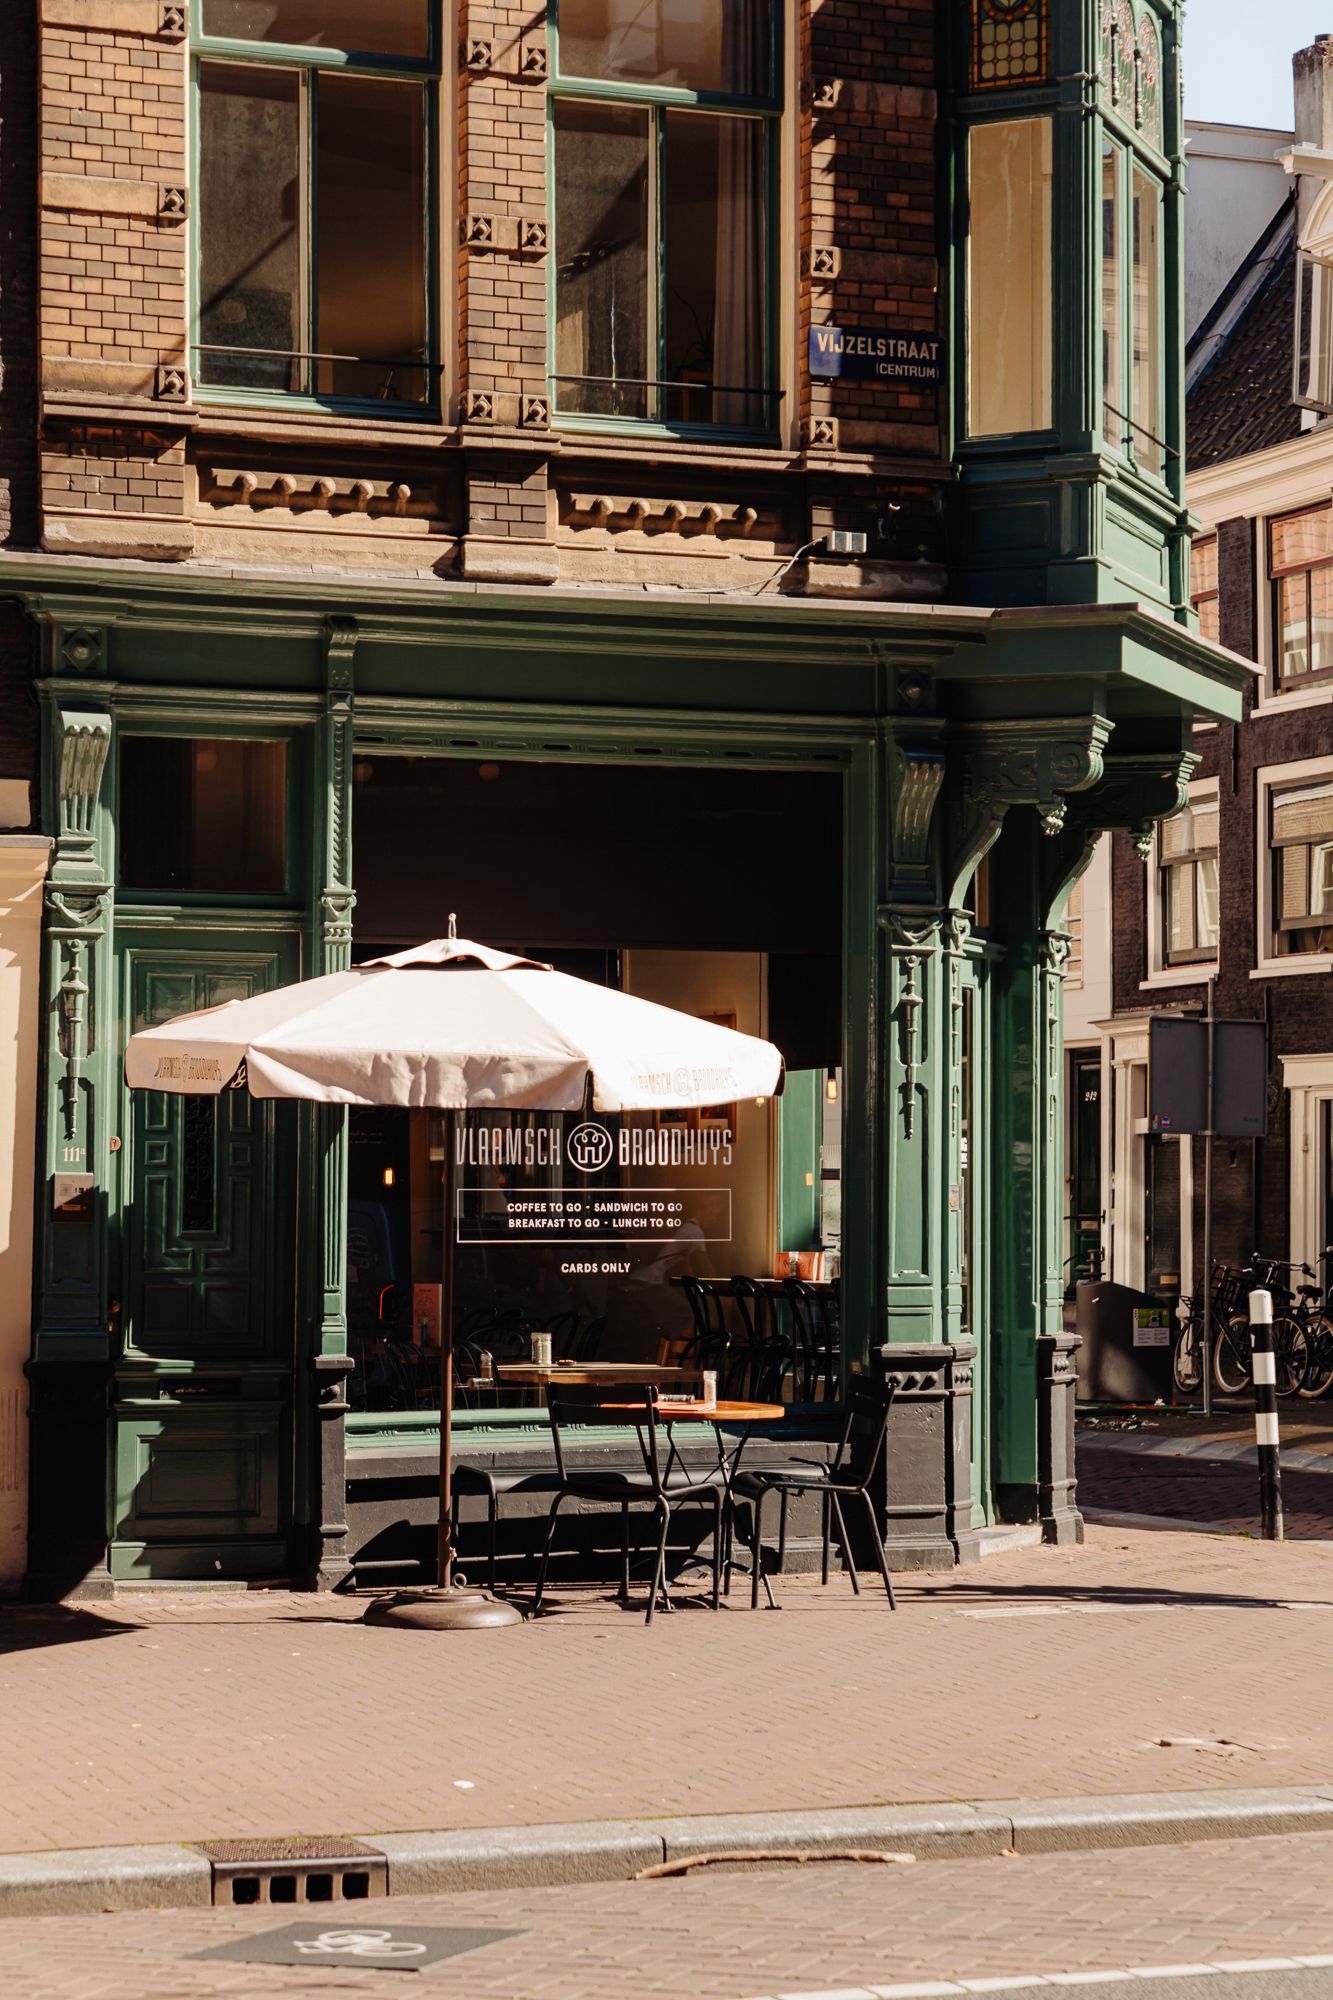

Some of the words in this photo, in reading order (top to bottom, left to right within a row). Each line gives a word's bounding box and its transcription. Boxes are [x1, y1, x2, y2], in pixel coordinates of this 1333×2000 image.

[817, 333, 939, 361] VIJZELSTRAAT
[876, 361, 940, 379] (CENTRUM)
[456, 1127, 561, 1166] VLAAMSCH
[619, 1128, 732, 1166] BROODHUYS
[507, 1203, 547, 1212] COFFEE
[549, 1203, 564, 1212] TO
[566, 1203, 582, 1212] GO
[594, 1203, 648, 1212] SANDWICH
[650, 1203, 665, 1212] TO
[667, 1203, 683, 1212] GO
[508, 1218, 566, 1228] BREAKFAST
[568, 1218, 582, 1228] TO
[584, 1218, 600, 1228] GO
[612, 1218, 647, 1227] LUNCH
[649, 1218, 664, 1227] TO
[666, 1218, 682, 1227] GO
[561, 1263, 598, 1273] CARDS
[601, 1263, 631, 1273] ONLY
